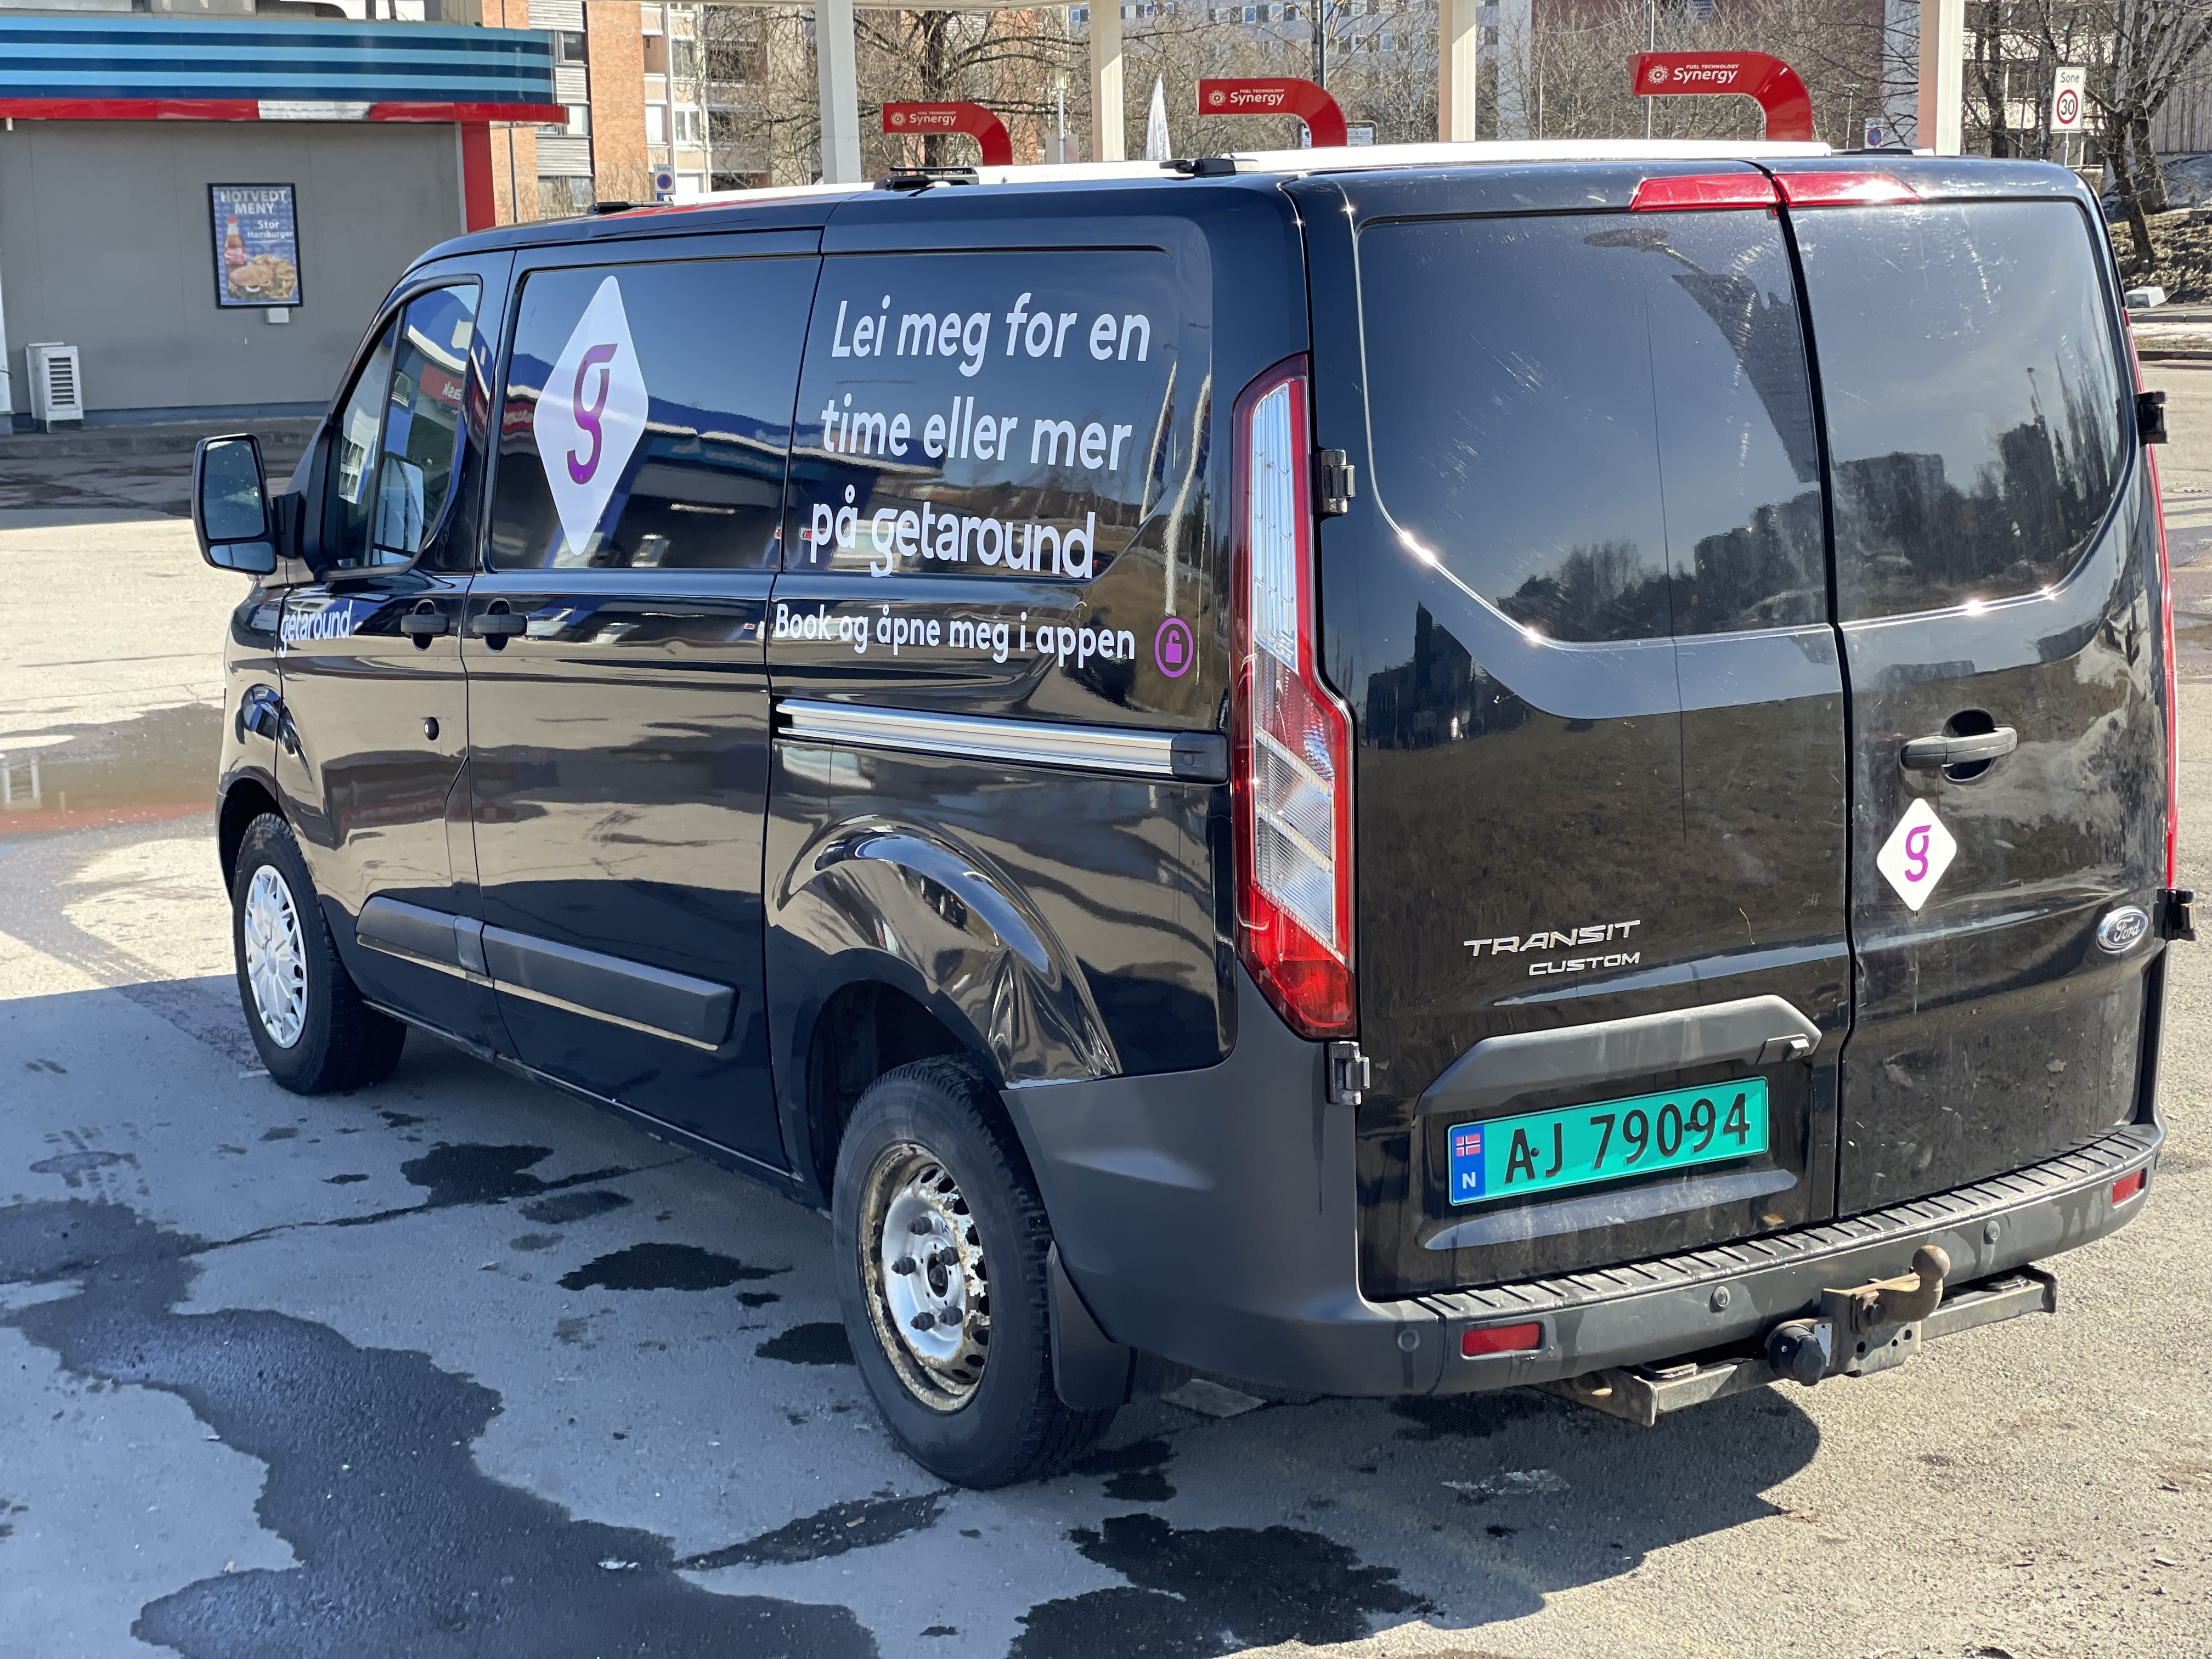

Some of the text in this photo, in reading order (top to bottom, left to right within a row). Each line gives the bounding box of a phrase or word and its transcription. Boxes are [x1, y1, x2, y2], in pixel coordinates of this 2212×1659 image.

[1673, 67, 1738, 83] Synergy
[2061, 72, 2080, 83] Sone
[1230, 92, 1284, 106] Synergy
[2061, 99, 2075, 115] 30
[909, 114, 956, 126] Synergy
[221, 190, 286, 202] HOTVEDT
[235, 202, 274, 215] MENY
[257, 220, 280, 229] Stor
[247, 230, 294, 239] Hamburger
[831, 292, 1150, 377] Lei meg for en
[821, 392, 1133, 471] time eller mer
[810, 484, 1096, 579] på getaround
[278, 599, 353, 659] getaround
[775, 603, 1136, 669] Book og åpne meg i appen
[1463, 919, 1641, 957] TRANSIT
[2113, 917, 2140, 942] Ford
[1528, 952, 1640, 976] CUSTOM
[1504, 1093, 1751, 1184] AJ 79094
[1462, 1171, 1476, 1189] N
